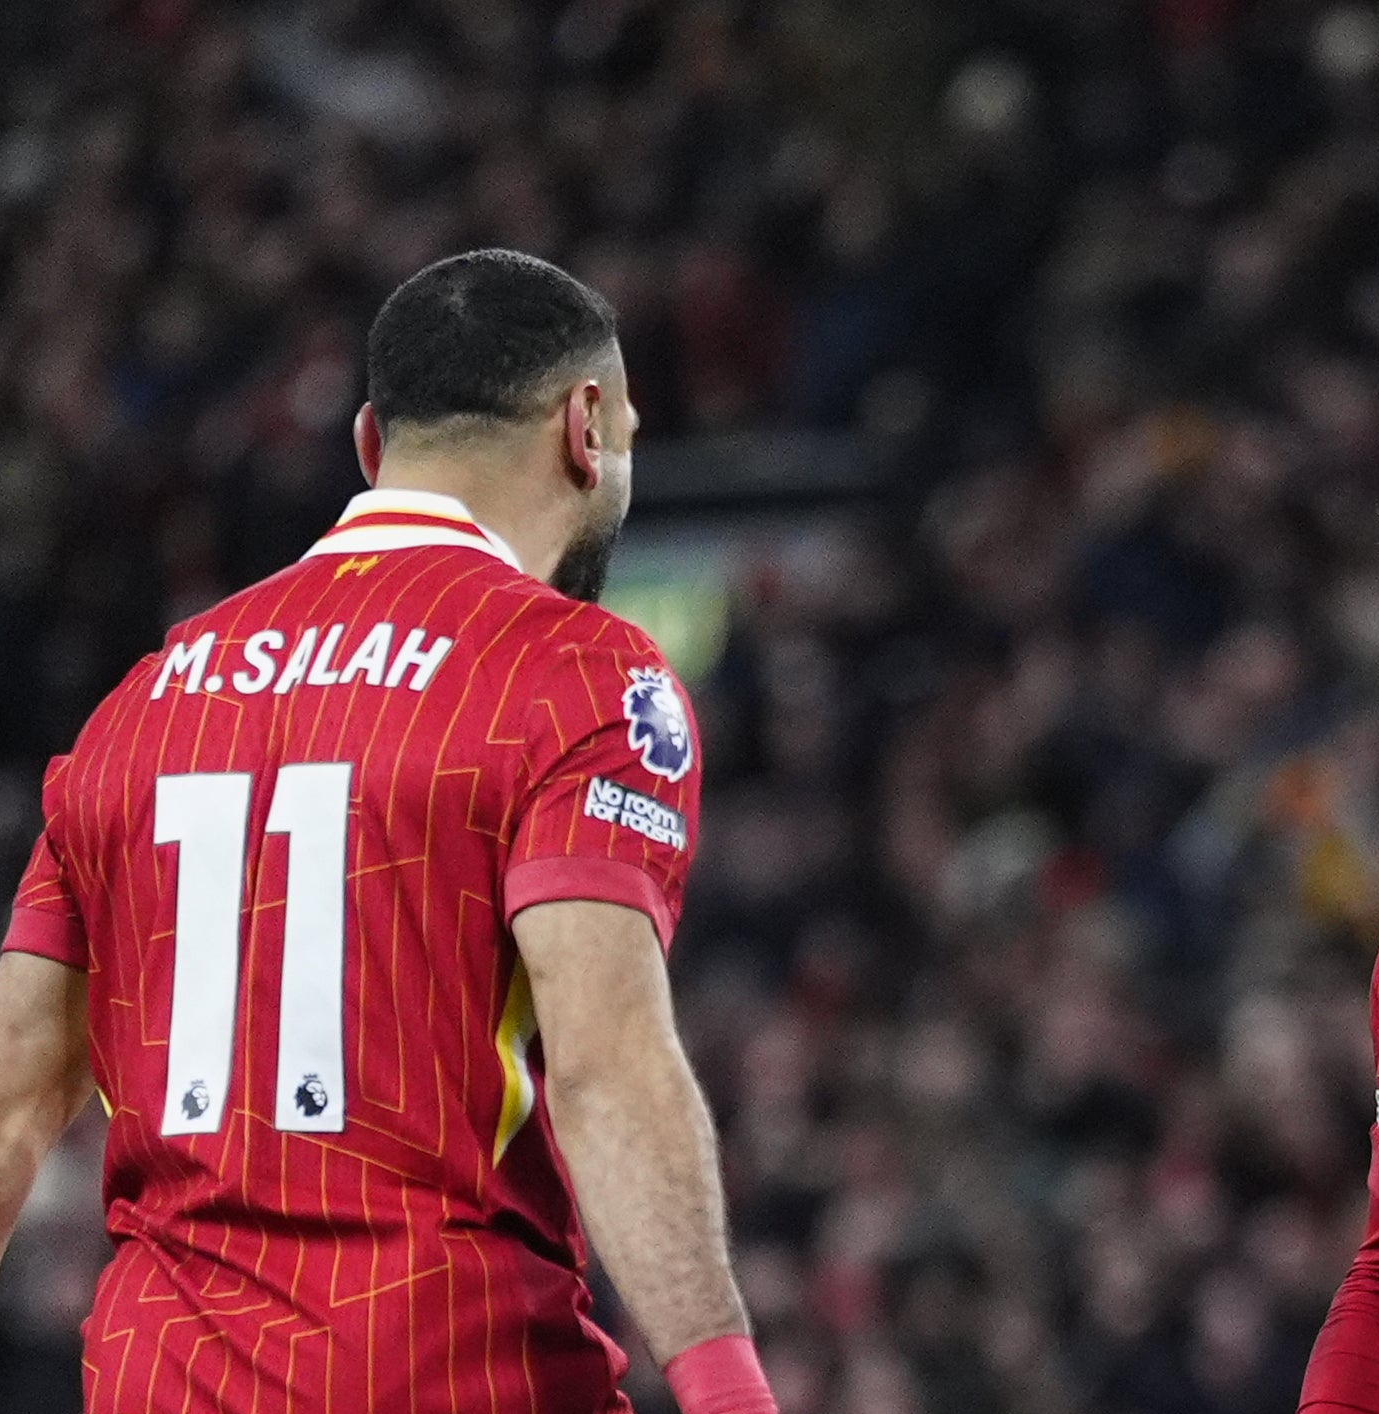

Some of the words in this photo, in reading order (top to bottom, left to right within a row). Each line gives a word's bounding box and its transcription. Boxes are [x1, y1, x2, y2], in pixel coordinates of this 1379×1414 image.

[585, 776, 623, 808] No
[623, 792, 681, 832] room
[620, 811, 686, 852] racism
[153, 762, 353, 1136] 11
